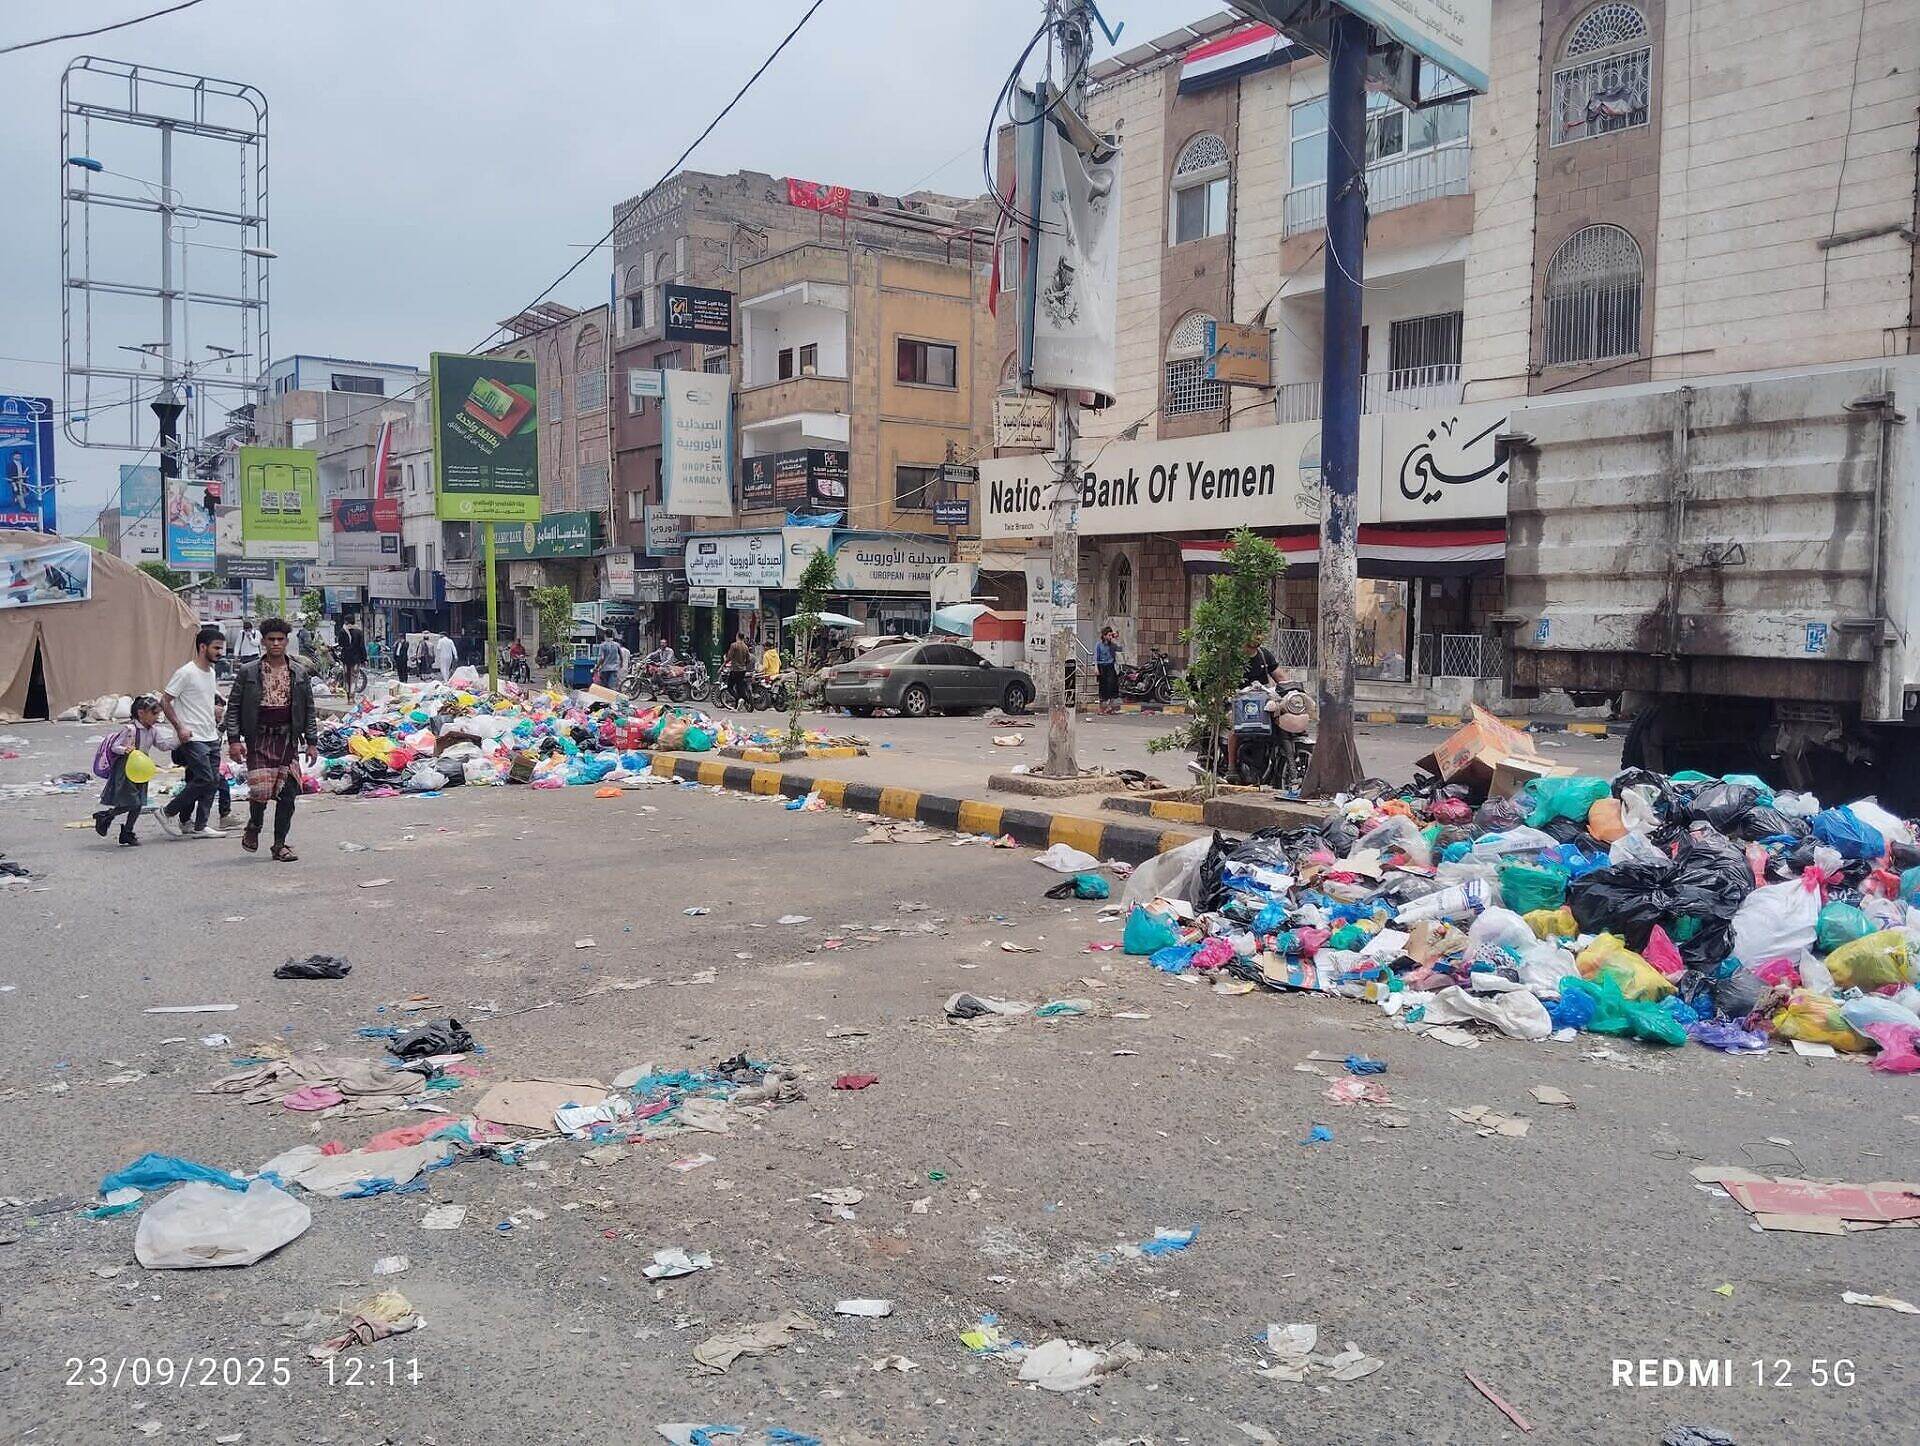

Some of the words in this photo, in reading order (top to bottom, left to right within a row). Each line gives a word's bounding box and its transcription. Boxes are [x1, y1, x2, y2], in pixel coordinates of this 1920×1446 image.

[681, 463, 722, 472] UROPEAN
[682, 476, 722, 485] HARMACY
[1082, 468, 1139, 508] Bank
[1149, 463, 1178, 504] Of
[1187, 461, 1275, 501] Yemen
[757, 552, 782, 569] لصيدلية
[856, 547, 905, 567] الأوروبية
[908, 551, 947, 567] صيدلية
